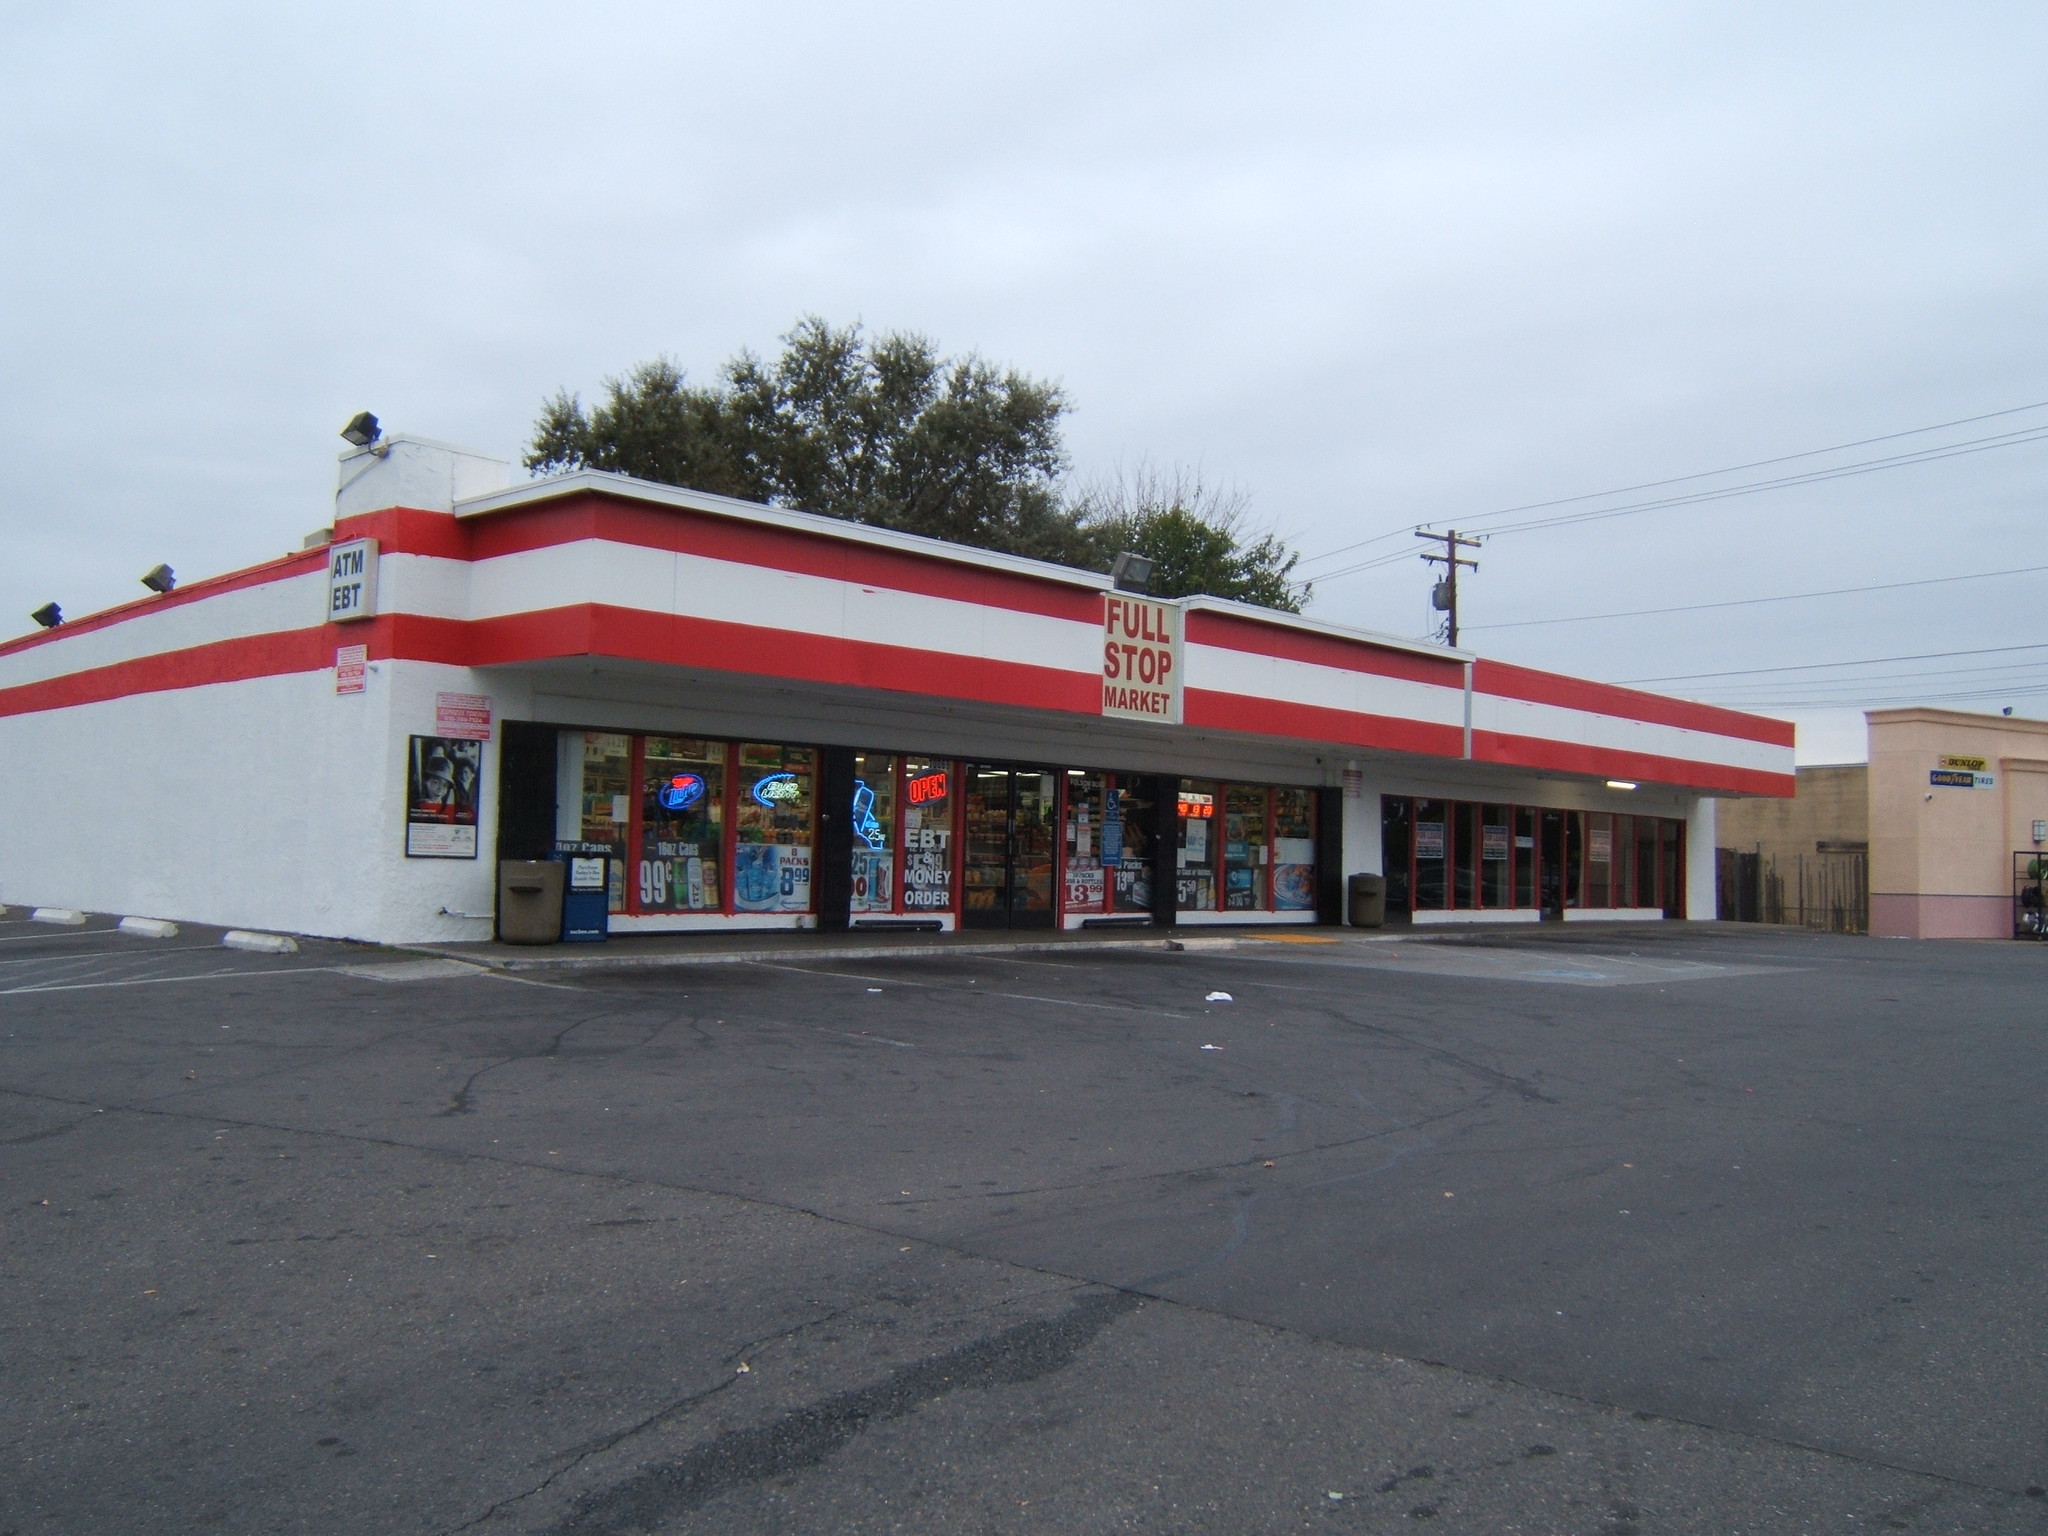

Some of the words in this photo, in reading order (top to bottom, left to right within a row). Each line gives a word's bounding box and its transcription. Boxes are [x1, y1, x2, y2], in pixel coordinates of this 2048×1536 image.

[333, 549, 363, 579] ATM
[333, 583, 361, 611] EBT
[1107, 598, 1170, 645] FULL
[1104, 641, 1172, 685] STOP
[1104, 685, 1170, 715] MARKET
[1948, 758, 1985, 768] DUNLOP
[909, 773, 947, 803] OPEN
[1975, 776, 1995, 785] TIRES
[904, 829, 951, 848] EBT
[679, 842, 699, 856] Cans
[923, 851, 933, 864] &
[780, 857, 809, 866] PACKS
[904, 870, 952, 884] MONEY
[904, 890, 950, 905] ORDER
